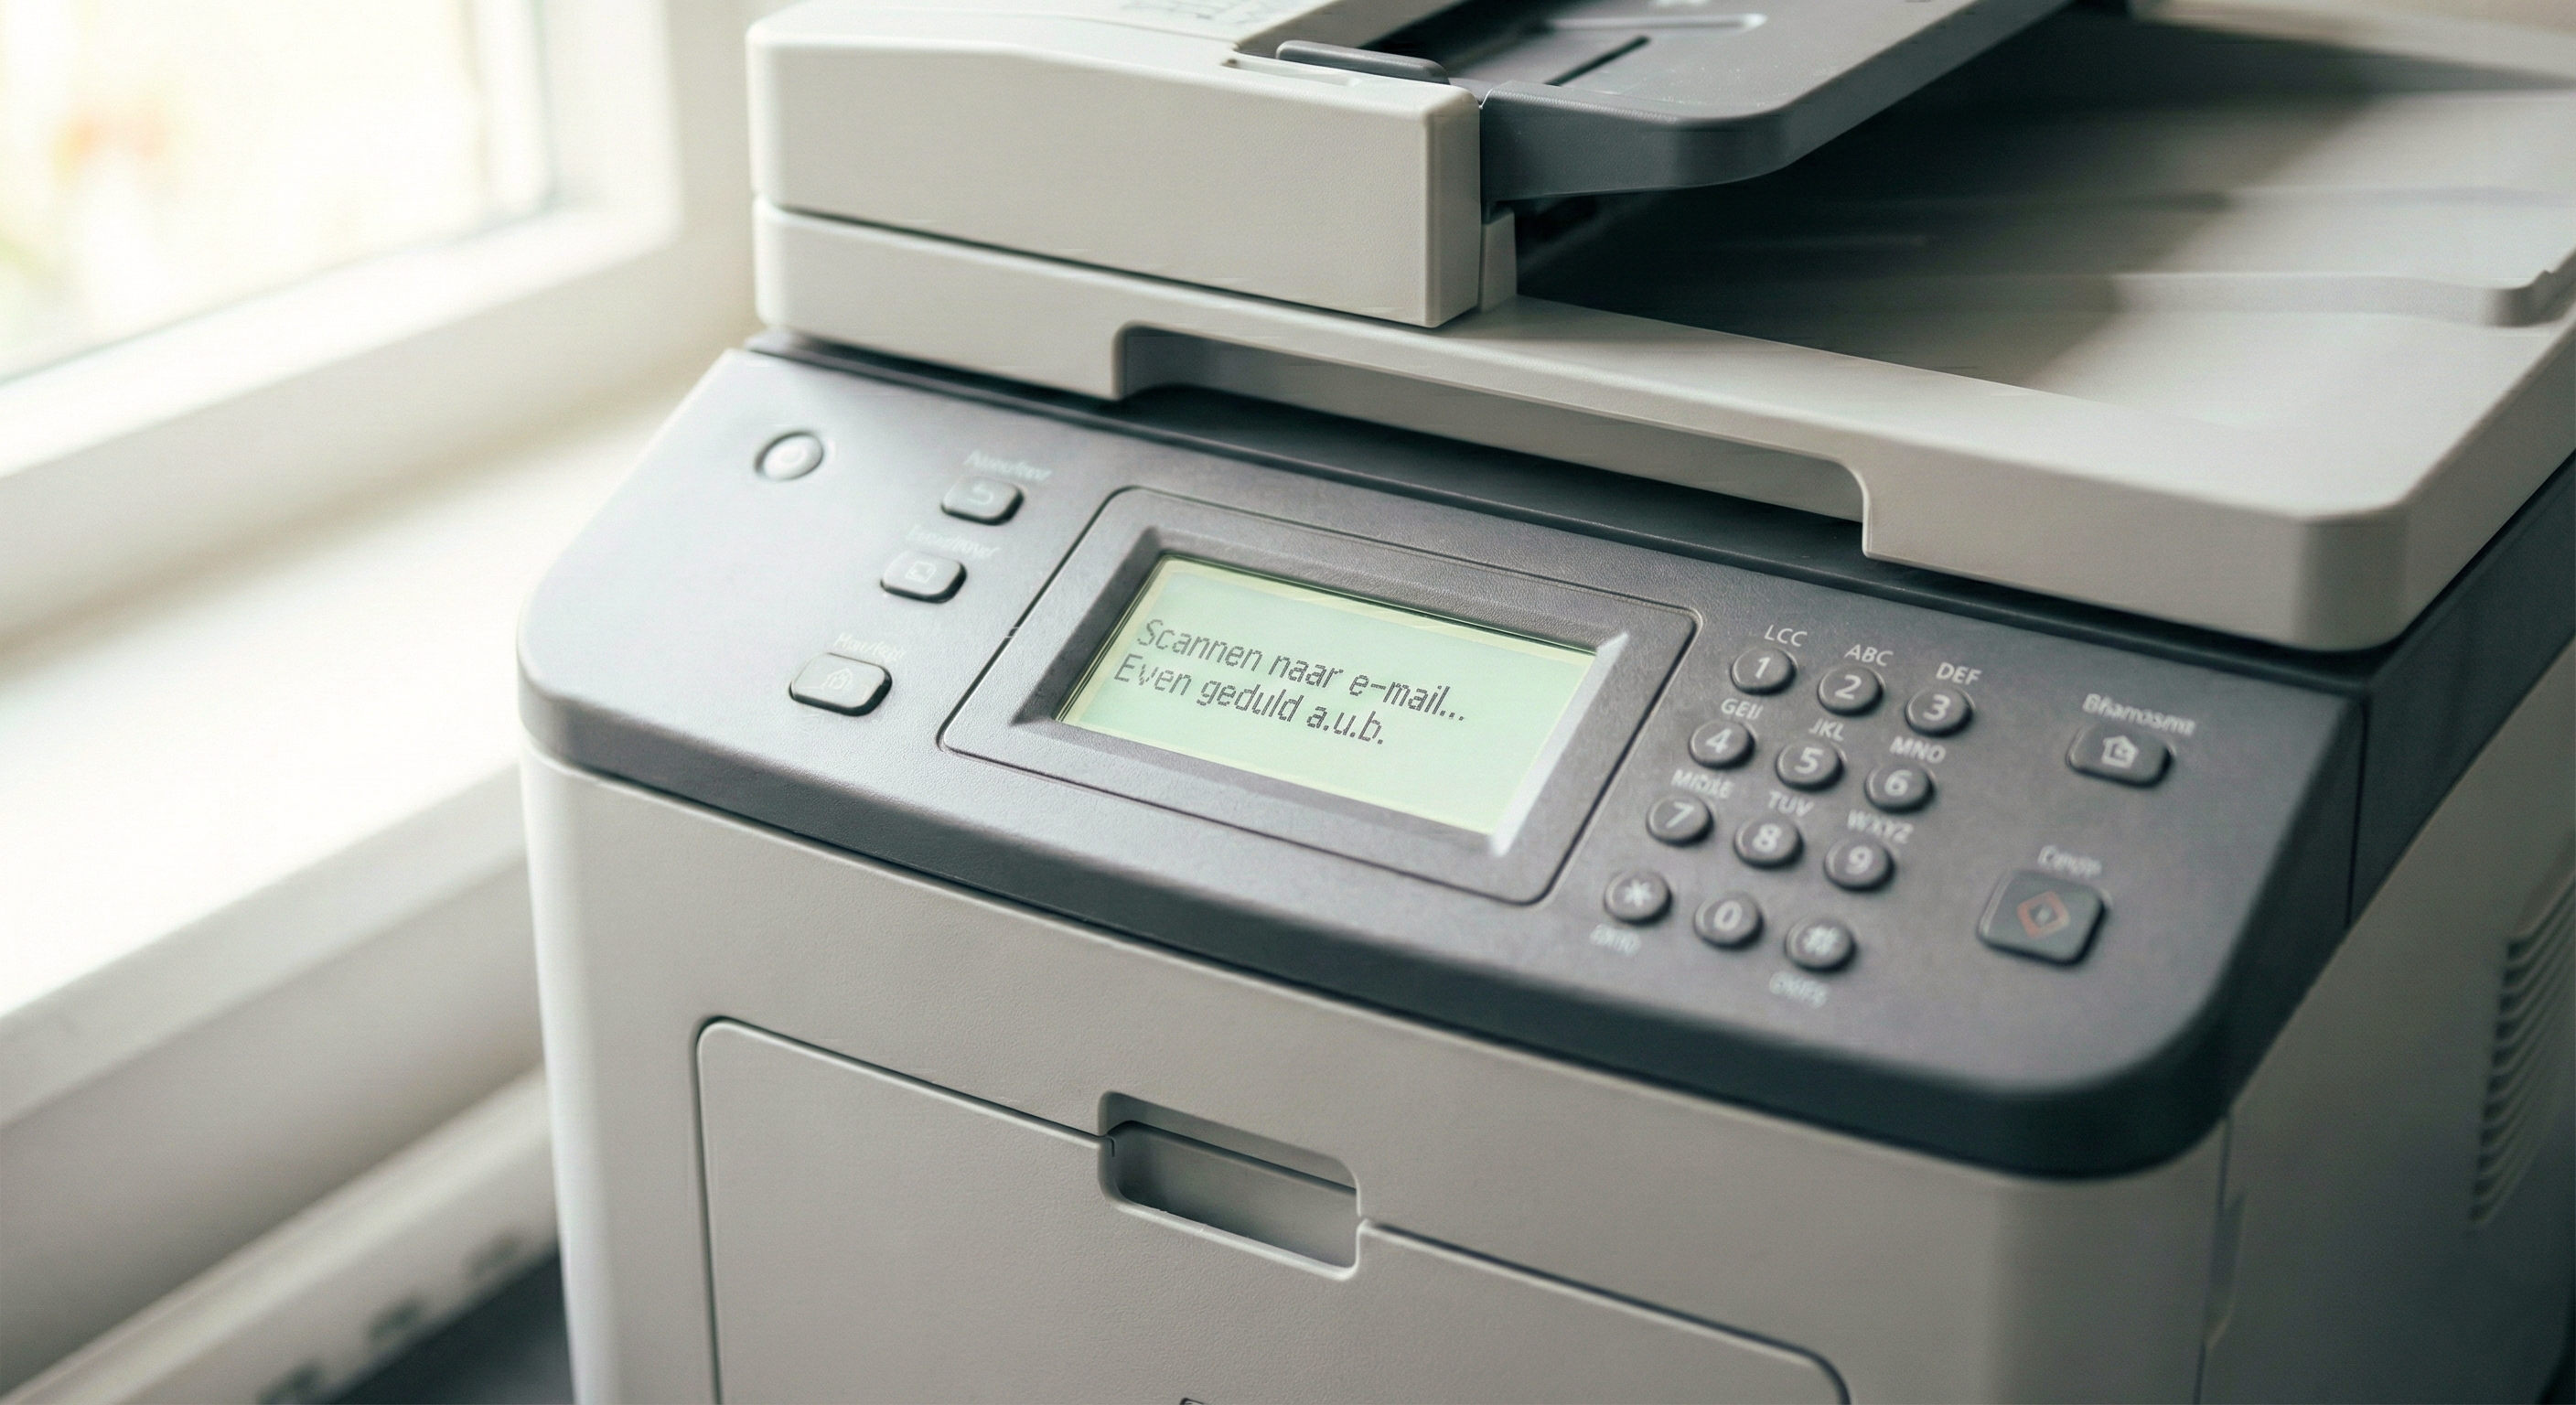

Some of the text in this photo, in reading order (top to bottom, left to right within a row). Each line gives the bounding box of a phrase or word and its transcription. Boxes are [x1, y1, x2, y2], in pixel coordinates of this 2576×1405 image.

[1765, 625, 1809, 648] LCC
[1755, 657, 1771, 680] 1
[1844, 643, 1894, 667] ABC
[1137, 618, 1465, 722] Scannen naar e-mail...
[1936, 662, 1981, 686] DEF
[1113, 653, 1385, 745] Even geduld a.u.b.
[1834, 675, 1862, 701] 2
[1922, 694, 1952, 722] 3
[1705, 728, 1730, 754] 4
[1809, 717, 1846, 742] JKL
[1795, 746, 1824, 774] 5
[1889, 736, 1947, 764] MNO
[1883, 769, 1912, 798] 6
[1664, 801, 1695, 829] 7
[1767, 791, 1815, 818] TUV
[1752, 824, 1783, 854] 8
[1846, 845, 1873, 874] 9
[1712, 901, 1744, 932] 0
